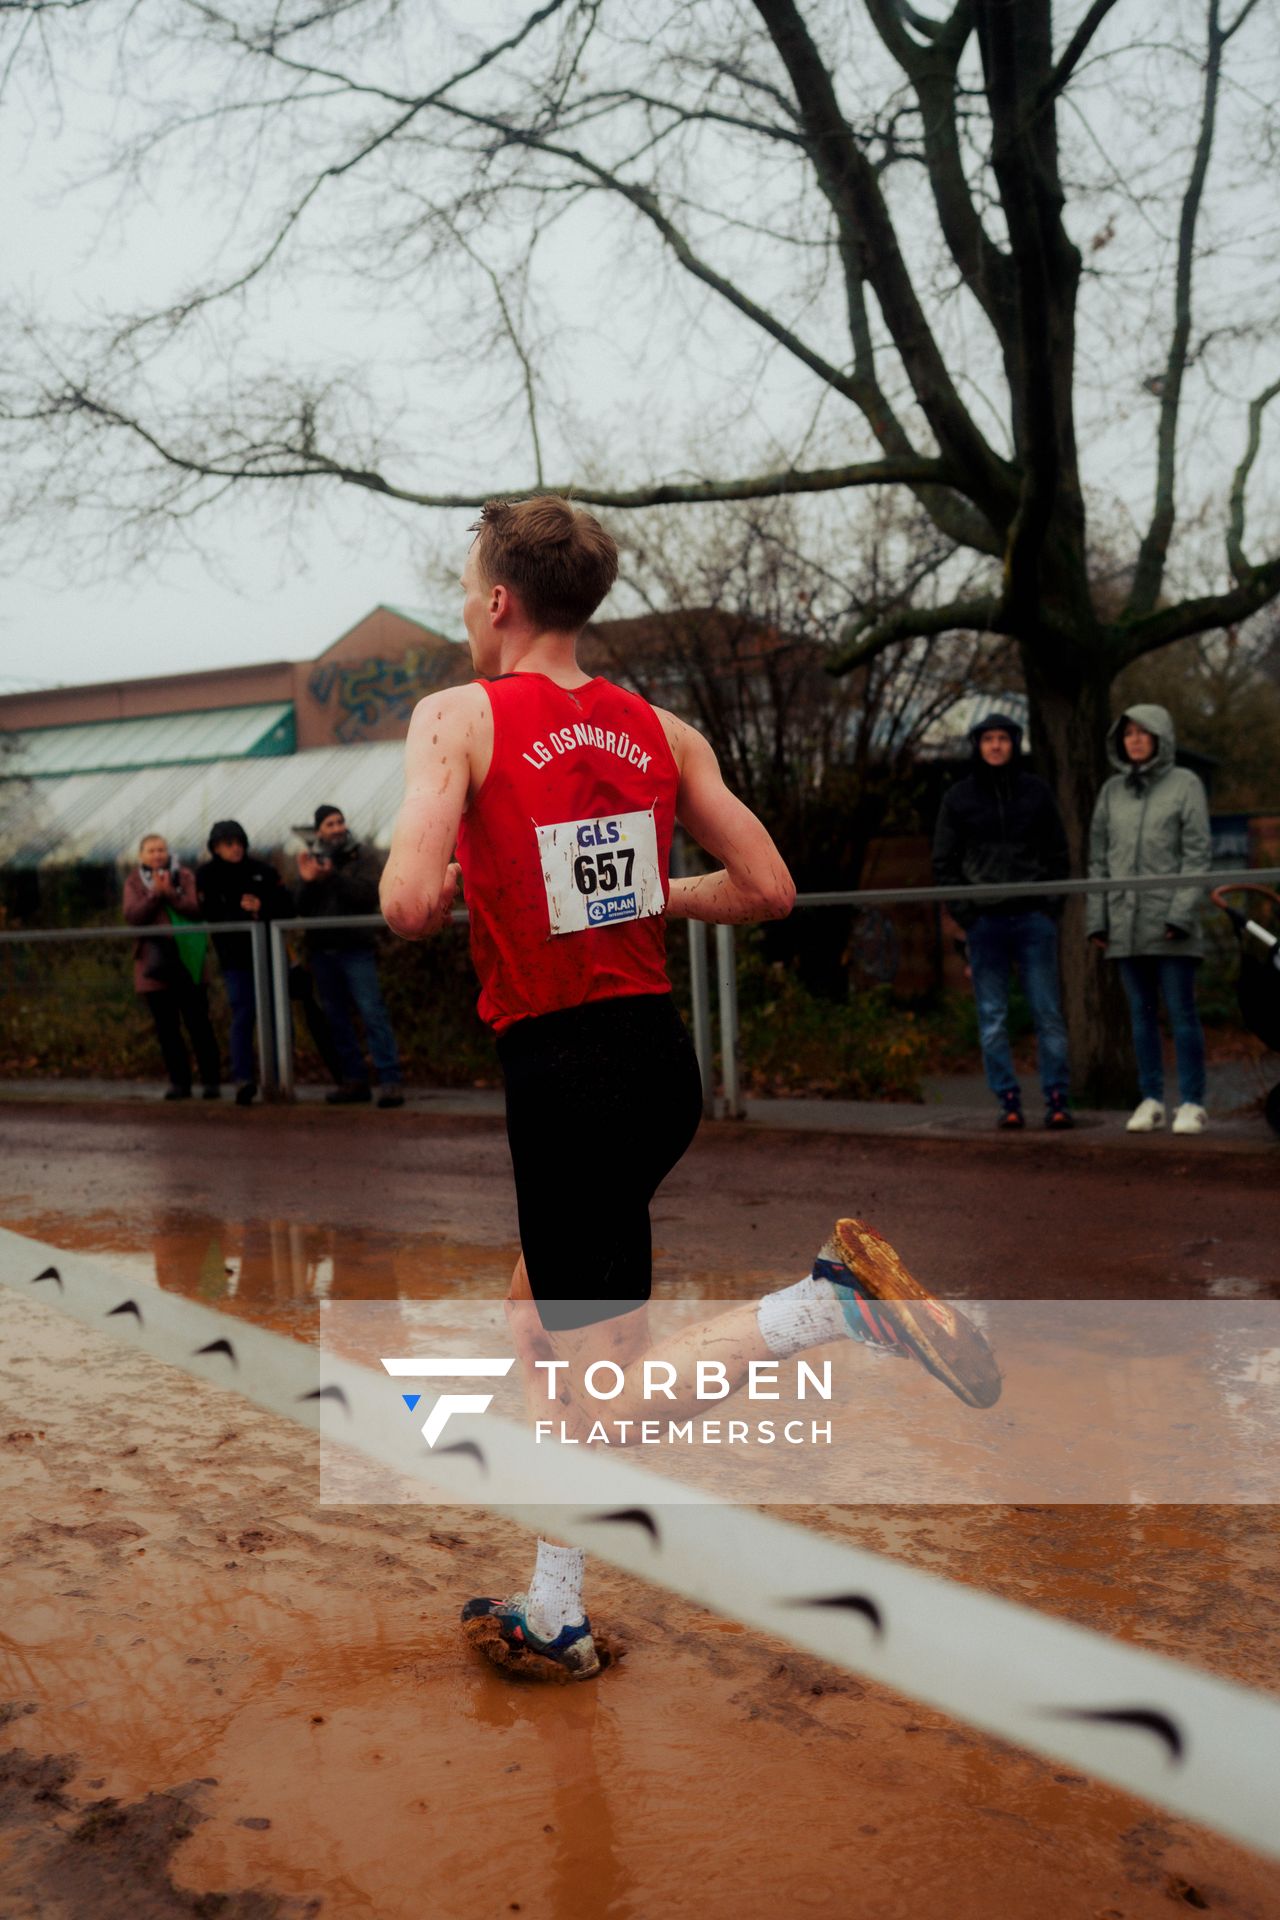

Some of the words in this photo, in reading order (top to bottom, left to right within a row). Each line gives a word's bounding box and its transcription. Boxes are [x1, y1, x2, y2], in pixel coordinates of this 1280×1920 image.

[522, 740, 554, 770] LG
[549, 722, 653, 774] OSNABRÜCK
[573, 847, 635, 895] 657
[607, 897, 635, 913] PLAN
